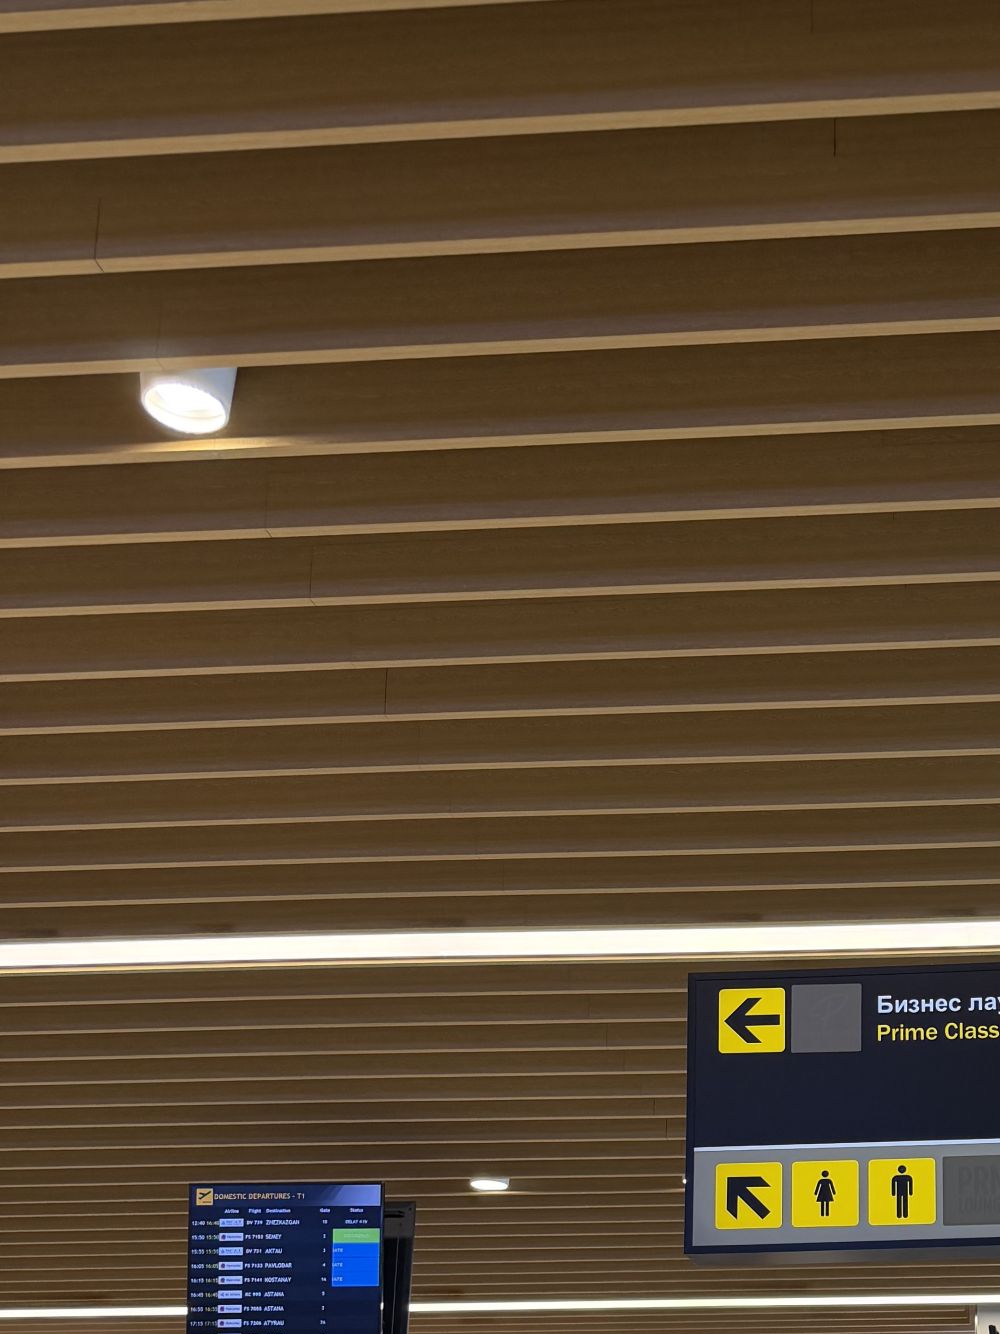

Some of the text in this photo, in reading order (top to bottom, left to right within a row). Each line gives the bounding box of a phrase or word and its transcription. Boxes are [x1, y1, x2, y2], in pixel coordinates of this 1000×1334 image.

[877, 995, 962, 1014] Бизнес
[877, 1023, 937, 1042] Prime
[944, 1022, 1000, 1041] Class
